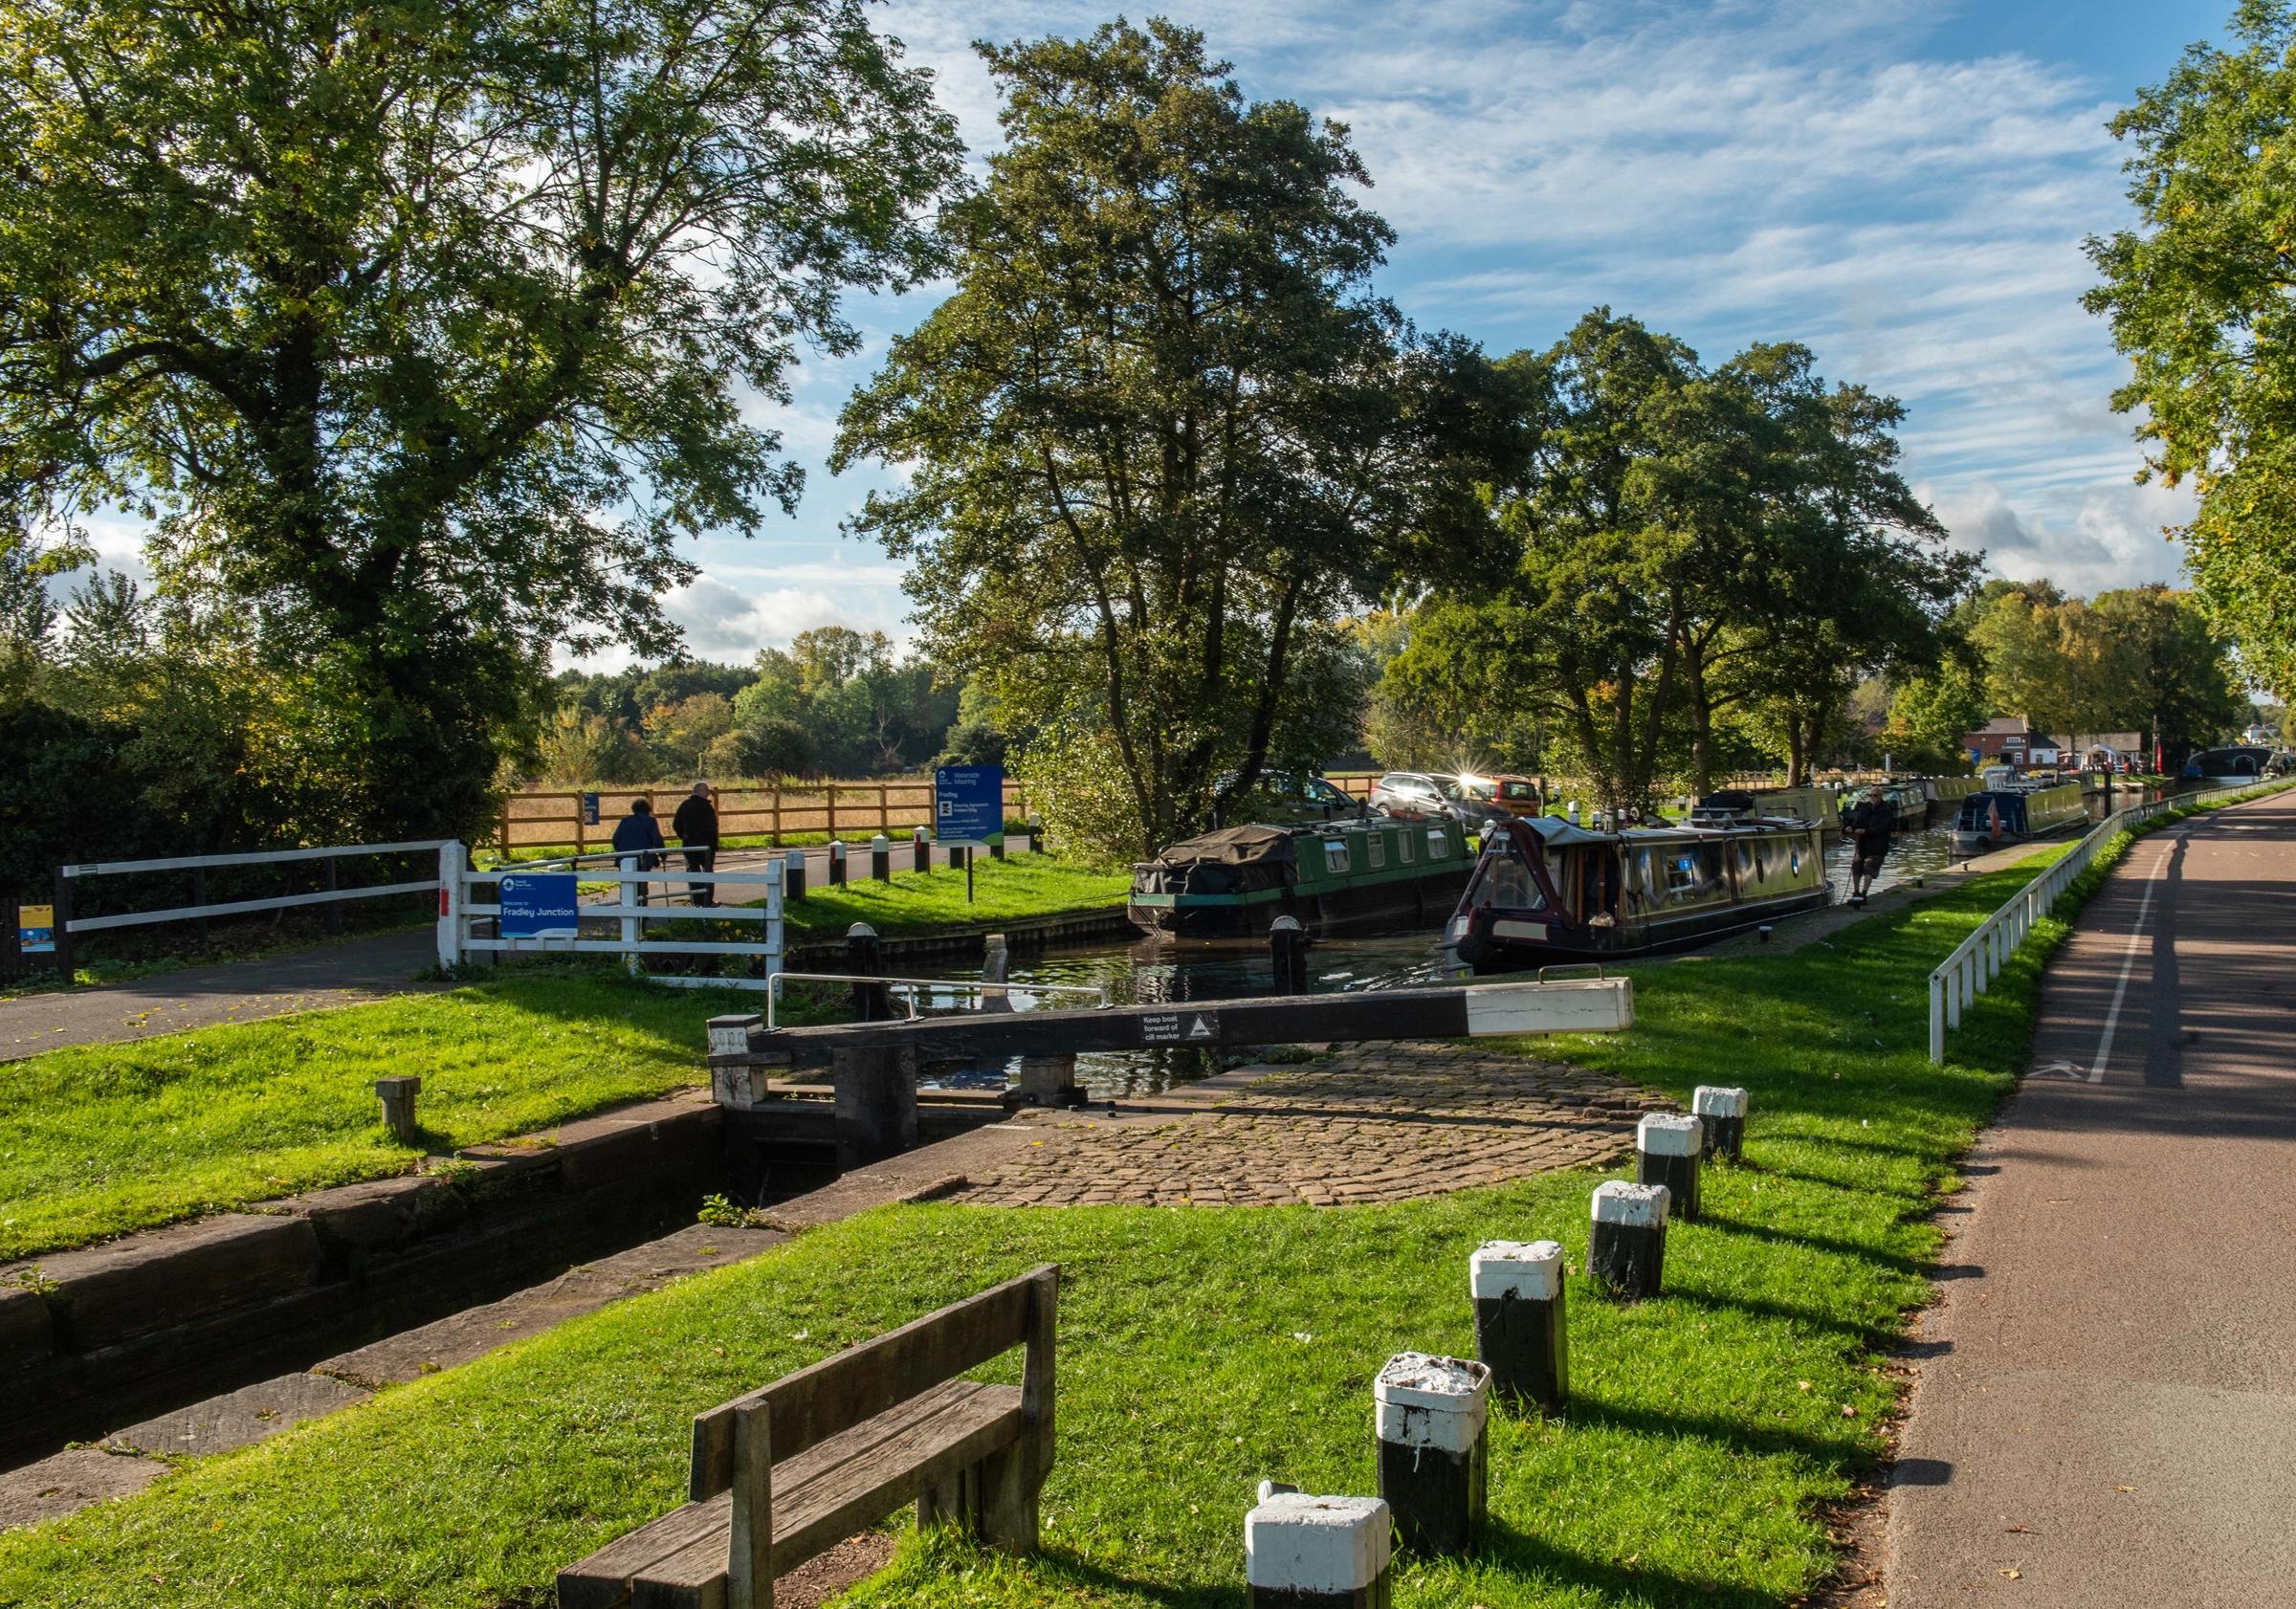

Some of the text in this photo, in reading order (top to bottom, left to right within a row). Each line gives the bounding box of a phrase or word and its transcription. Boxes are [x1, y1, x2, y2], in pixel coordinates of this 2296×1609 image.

[503, 907, 574, 918] Fradley Junction
[1143, 1016, 1161, 1025] Keep
